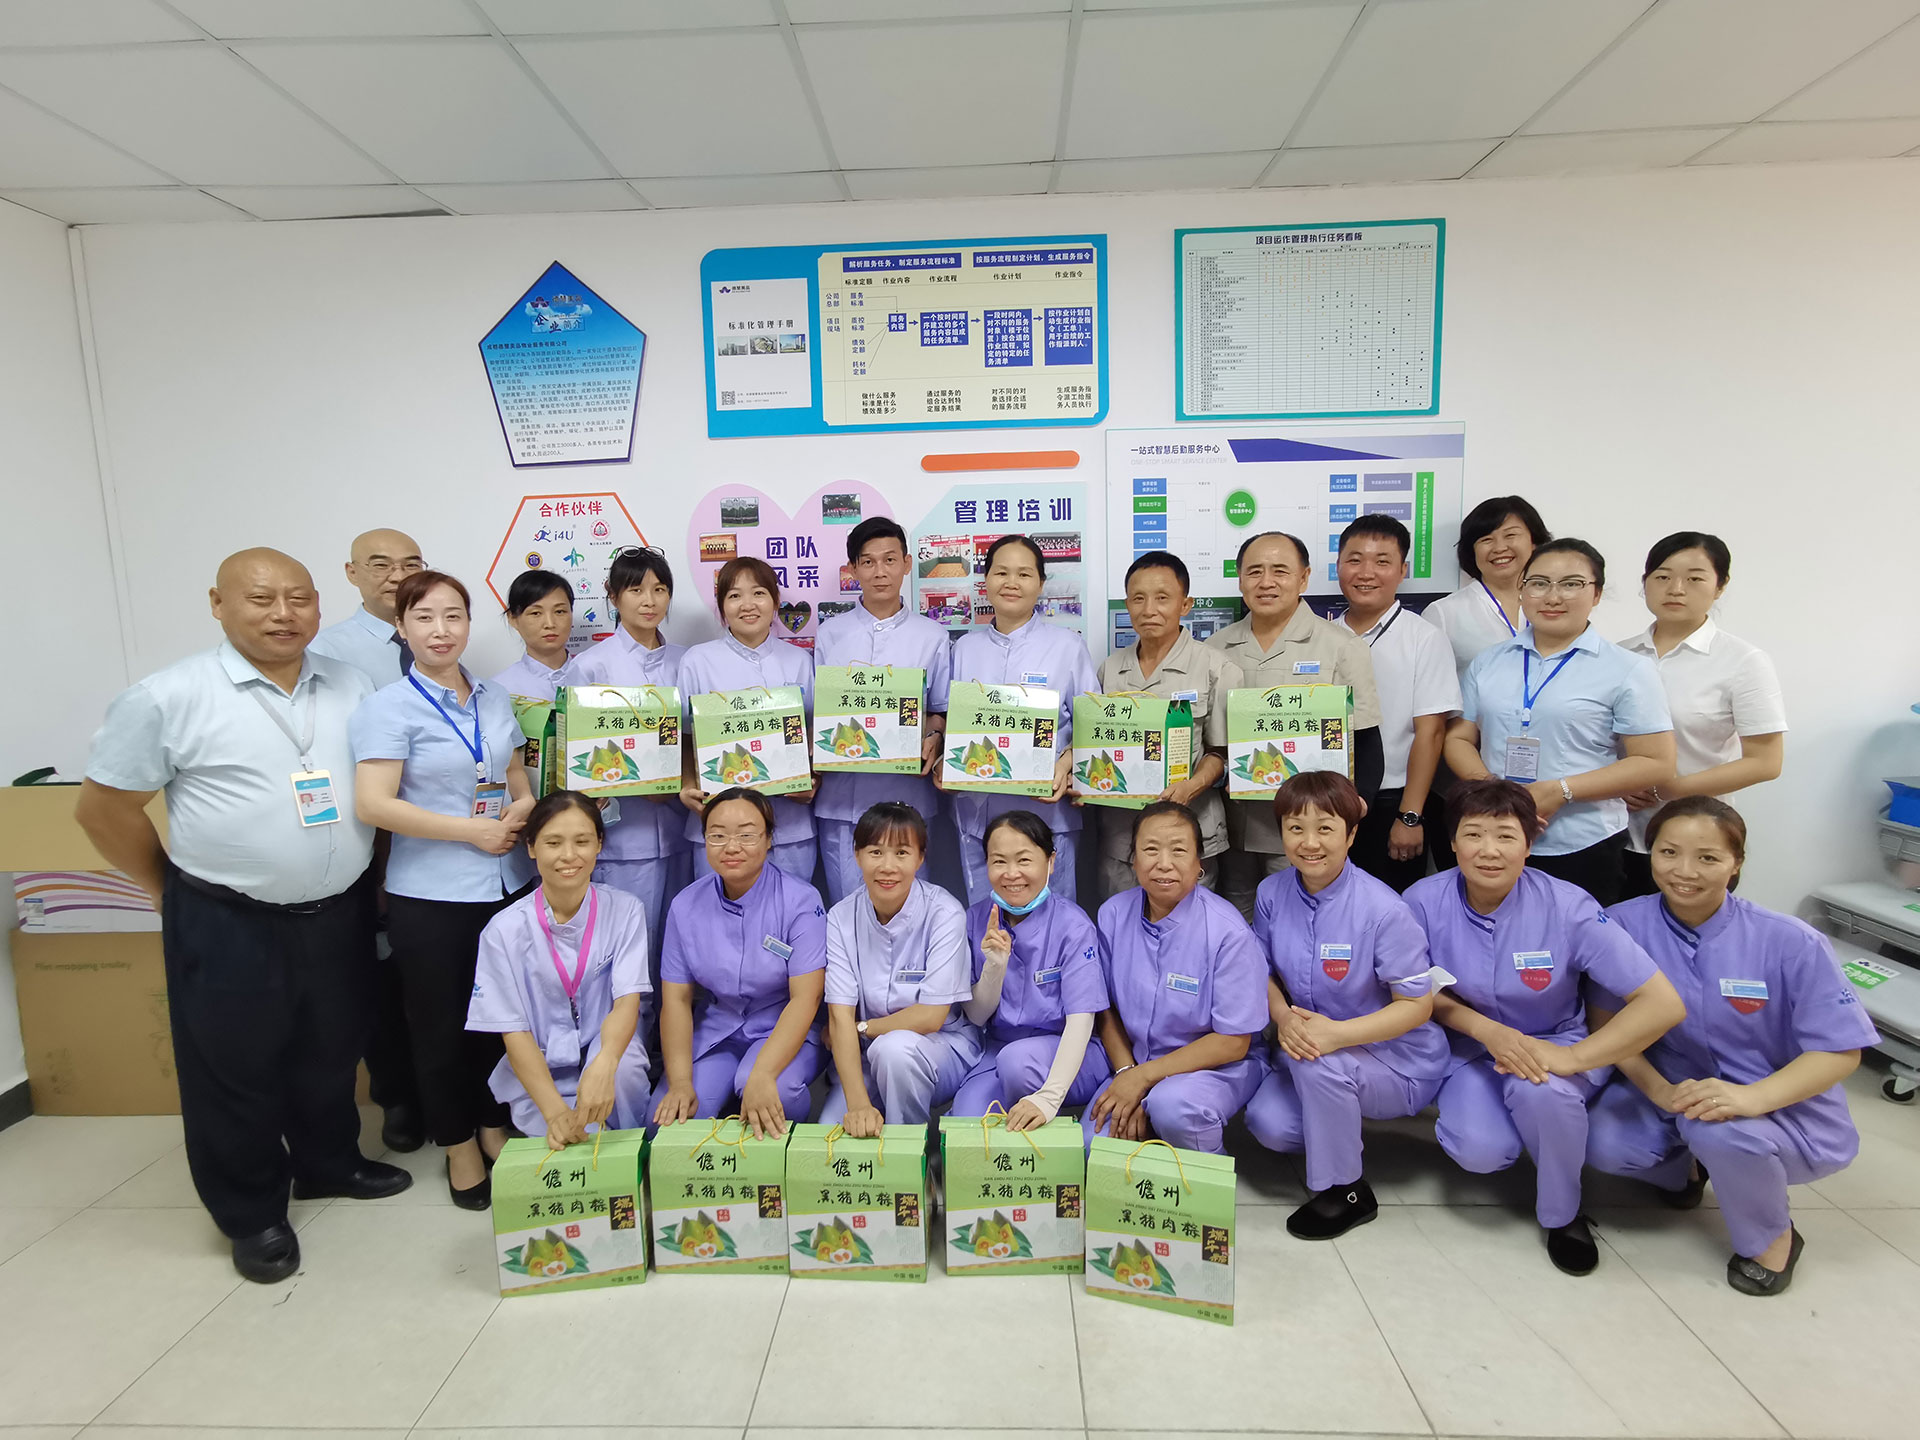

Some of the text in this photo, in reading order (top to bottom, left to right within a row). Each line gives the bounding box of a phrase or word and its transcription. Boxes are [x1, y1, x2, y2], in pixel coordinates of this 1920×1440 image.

[1256, 232, 1363, 245] 项目运作管理执行任务看板
[882, 276, 911, 284] 作业内容
[929, 275, 958, 283] 作业流程
[1055, 271, 1084, 279] 作业指令
[845, 278, 873, 286] 标准定额
[890, 315, 905, 323] 服务
[1048, 308, 1091, 317] 按作业计划自
[534, 312, 581, 333] 企业简介
[728, 319, 794, 330] 标准化管理手册
[891, 323, 905, 331] 内容
[923, 320, 966, 328] 序建立的多个
[986, 318, 1030, 326] 对不同的服务
[1048, 316, 1091, 325] 动生成作业指
[923, 328, 966, 336] 服务内容组成
[988, 357, 1009, 365] 务清单
[862, 391, 897, 399] 做什么服务
[927, 389, 961, 397] 通过服务的
[991, 387, 1026, 395] 对不同的对
[1057, 393, 1092, 401] 令派工给服
[862, 399, 897, 407] 标准是什么
[927, 397, 962, 405] 组合达到特
[992, 402, 1027, 410] 的服务流程
[862, 407, 897, 415] 绩效是多少
[1131, 445, 1220, 455] 一站式智慧后勤服务中心
[539, 501, 603, 517] 合作伙伴
[954, 498, 1073, 523] 管理培训
[554, 529, 574, 541] i4U
[766, 536, 819, 559] 团队
[775, 565, 820, 588] 风采
[1192, 598, 1214, 607] 中心
[852, 671, 884, 687] 儋州
[838, 695, 898, 709] 黑猪肉粽
[1267, 693, 1302, 708] 儋州
[1103, 703, 1132, 720] 儋州
[594, 716, 657, 730] 黑猪肉粽
[720, 718, 782, 735] 黑猪肉粽
[972, 713, 1033, 730] 黑猪肉粽
[1253, 719, 1320, 732] 黑猪肉粽
[1092, 727, 1143, 743] 黑猪肉粽
[696, 1152, 737, 1173] 儋州
[832, 1158, 873, 1179] 儋州
[993, 1152, 1035, 1173] 儋州
[542, 1166, 586, 1189] 儋州
[682, 1184, 756, 1199] 黑猪肉粽
[978, 1183, 1055, 1199] 黑猪肉粽
[1135, 1179, 1179, 1207] 儋州
[817, 1189, 893, 1207] 黑猪肉粽
[527, 1198, 608, 1219] 黑猪肉粽
[1118, 1209, 1200, 1238] 黑猪肉粽
